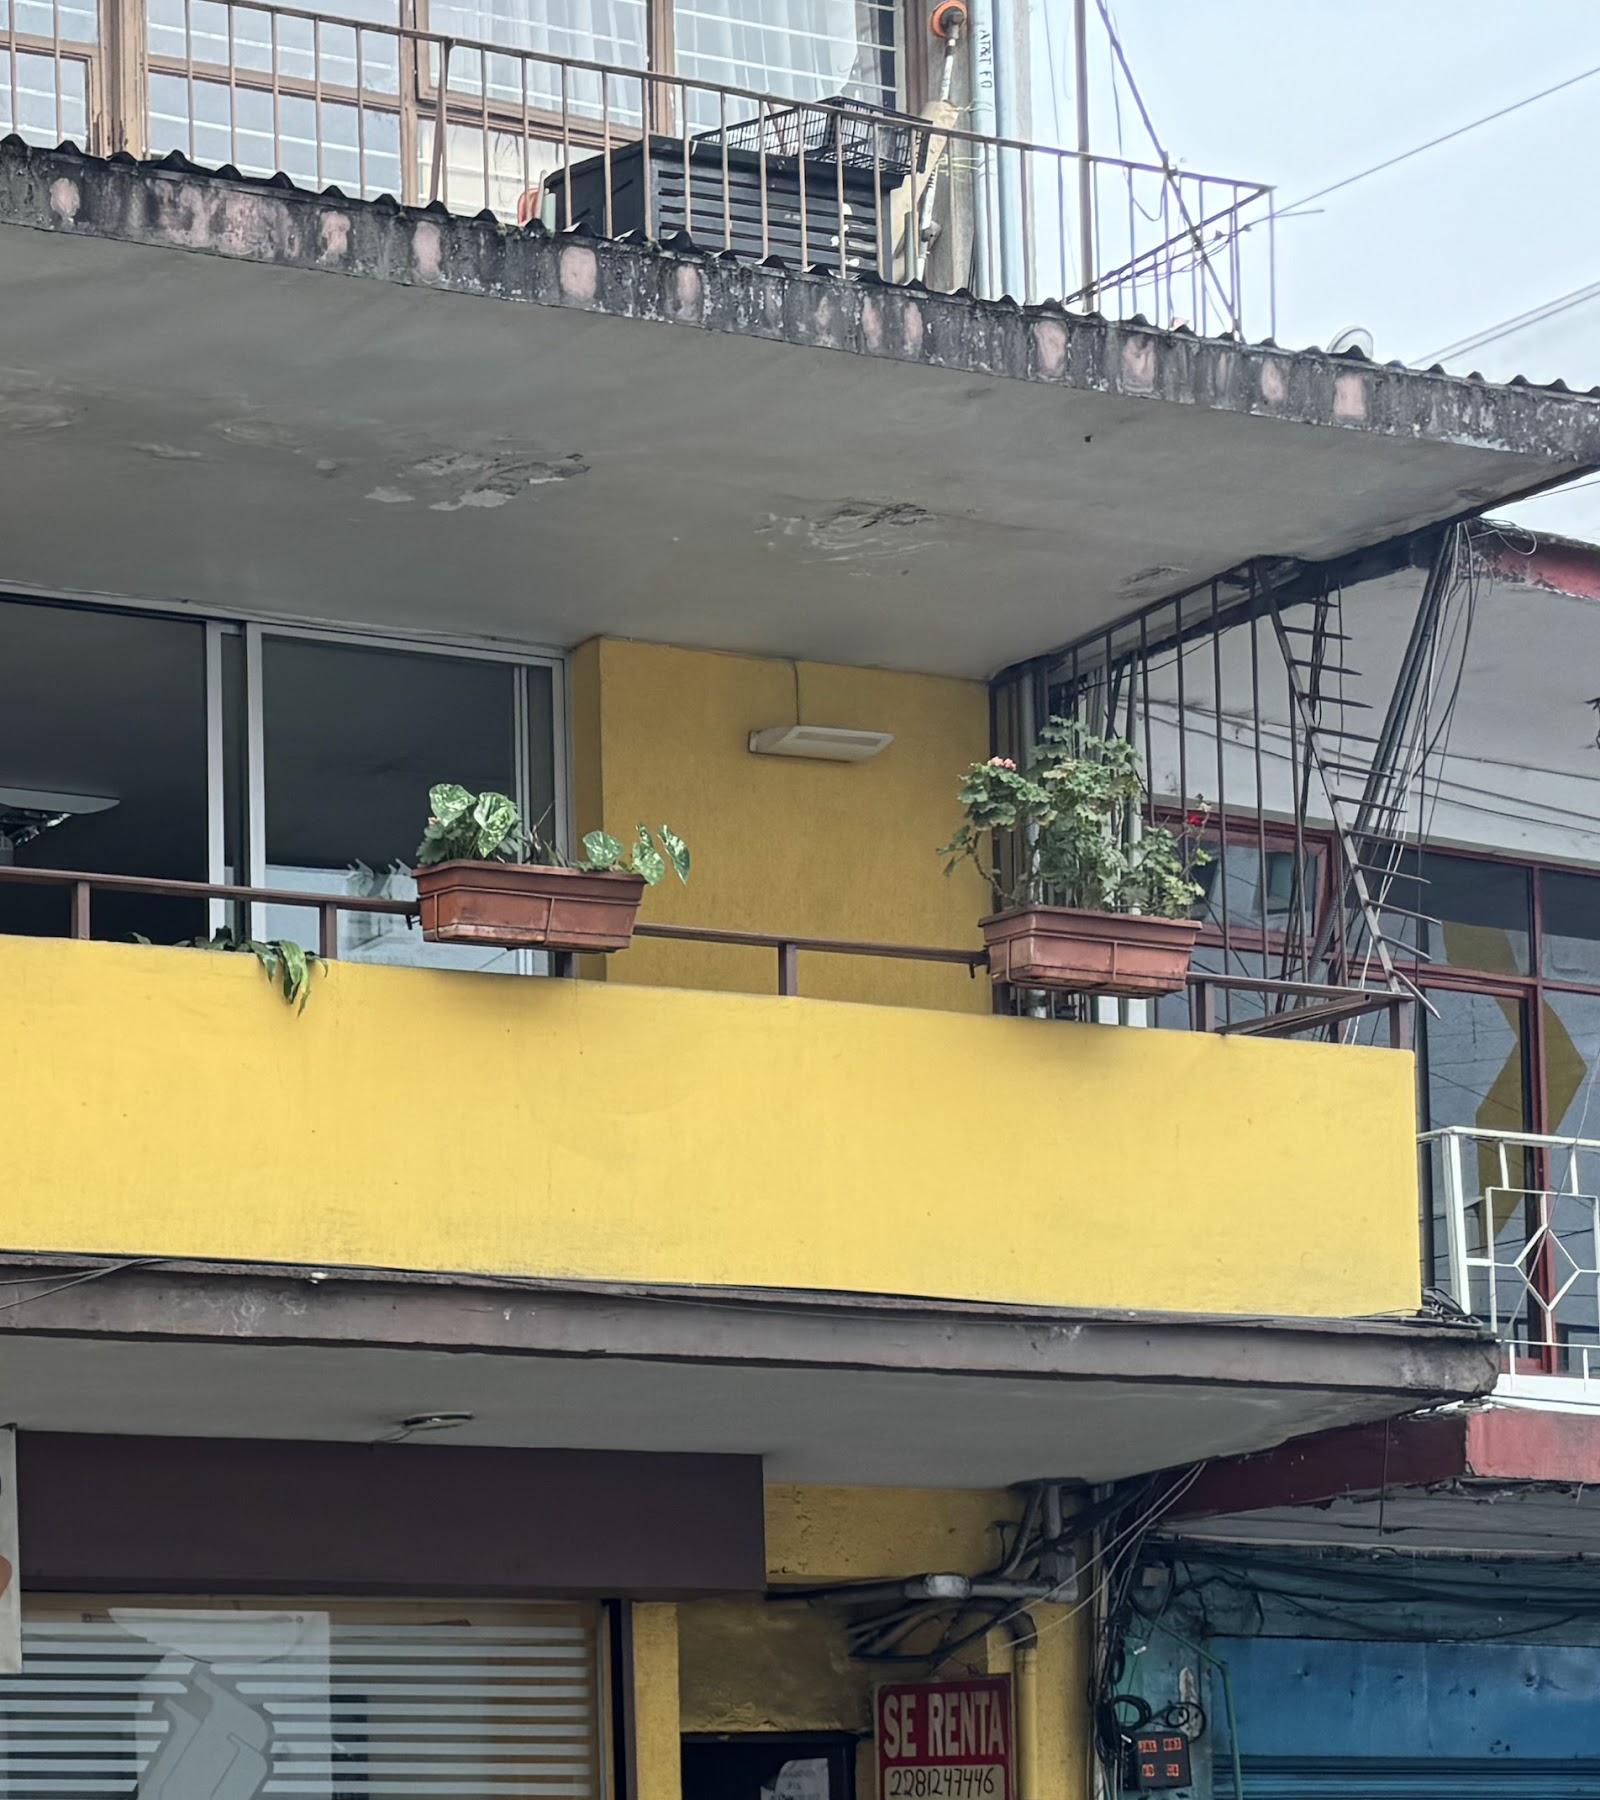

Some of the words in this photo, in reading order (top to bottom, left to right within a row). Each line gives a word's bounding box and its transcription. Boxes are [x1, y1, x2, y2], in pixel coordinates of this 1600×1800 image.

[883, 1694, 917, 1759] SE
[927, 1690, 1006, 1757] RENTA
[889, 1767, 995, 1799] 2281247446
